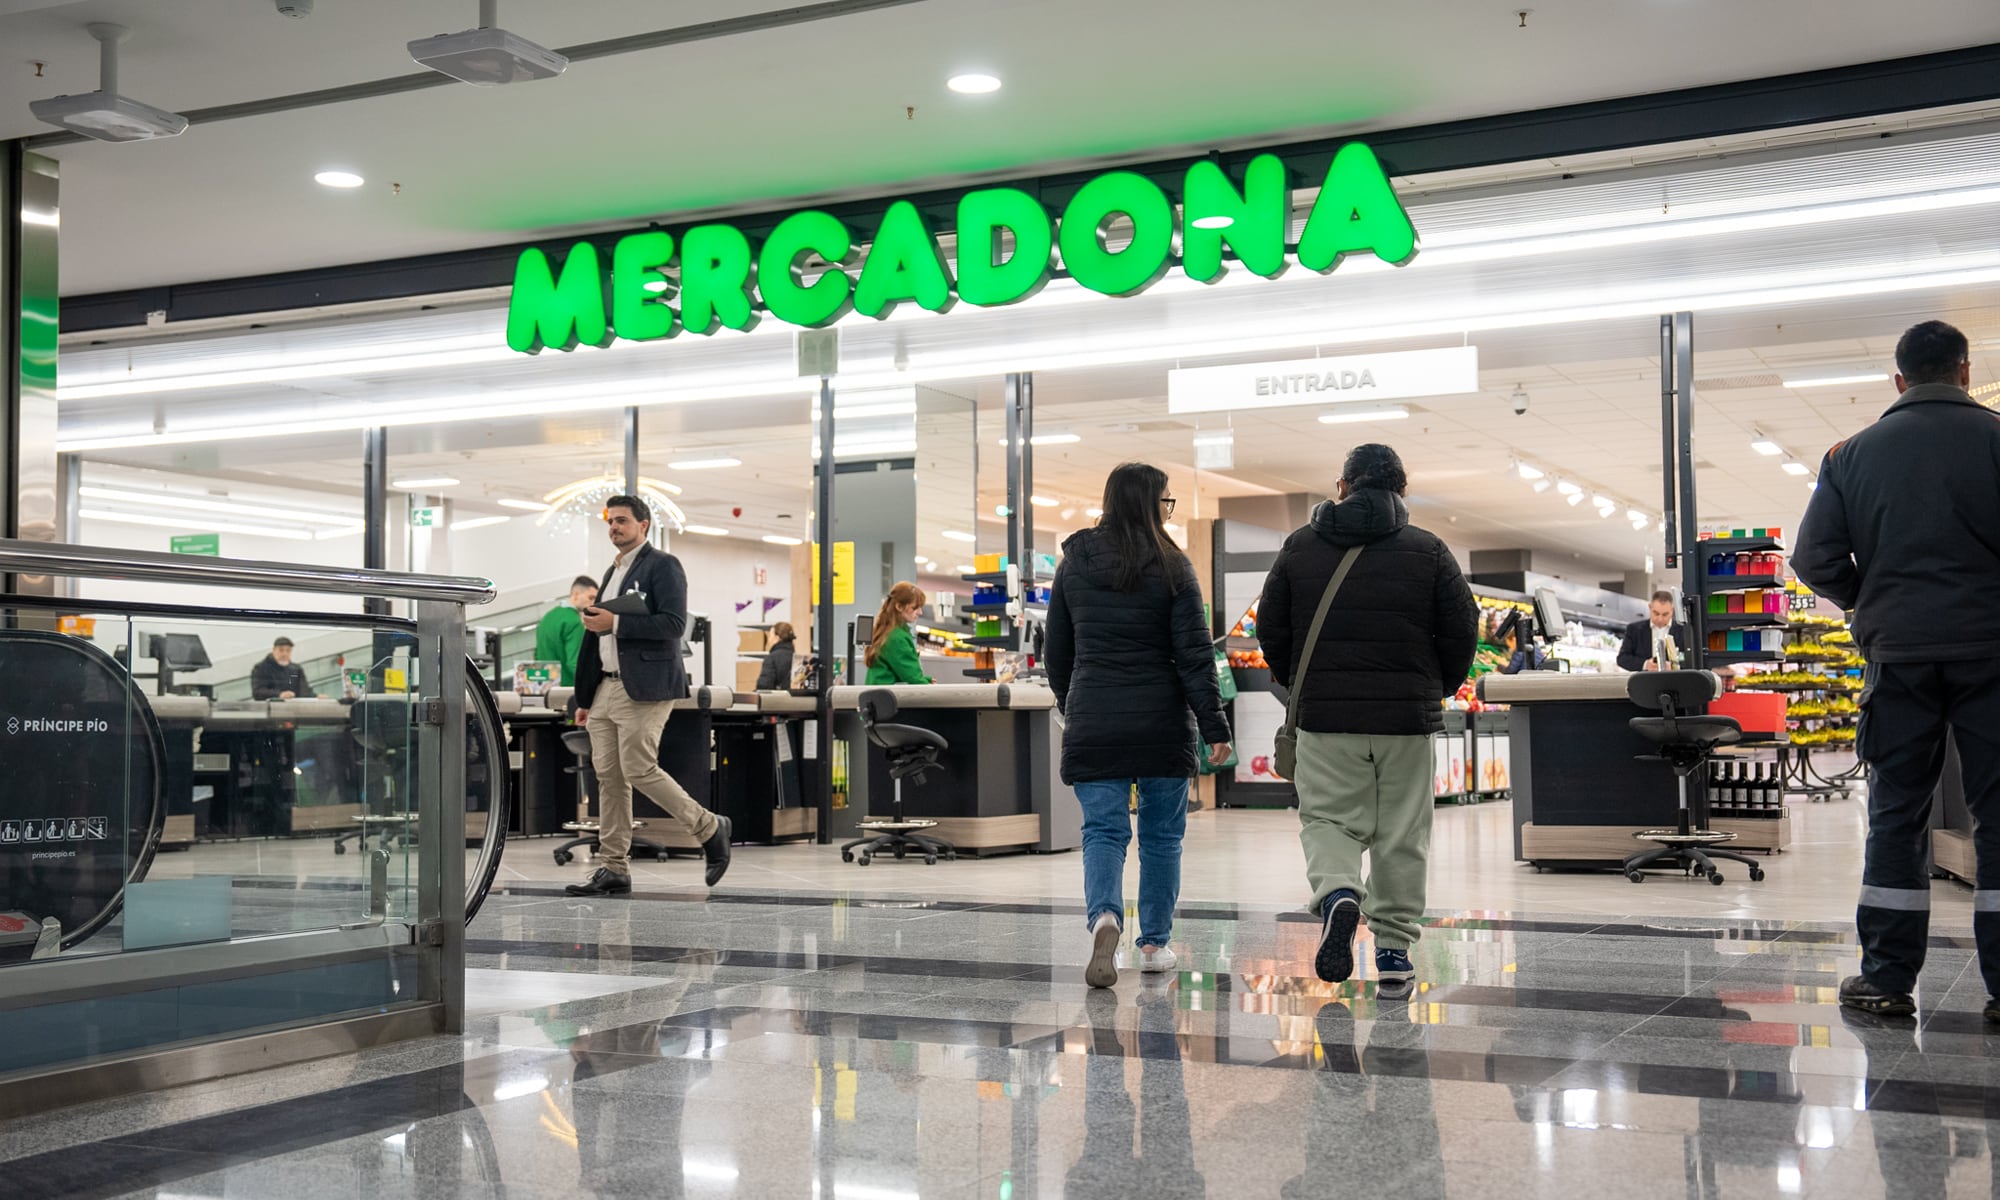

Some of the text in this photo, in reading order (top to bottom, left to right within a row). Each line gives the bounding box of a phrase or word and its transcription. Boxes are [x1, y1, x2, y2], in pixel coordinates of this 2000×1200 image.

[507, 142, 1418, 354] MERCADONA
[1255, 368, 1376, 396] ENTRADA
[23, 717, 108, 732] PRÍNCIPE PÍO
[31, 851, 76, 860] principepio.es
